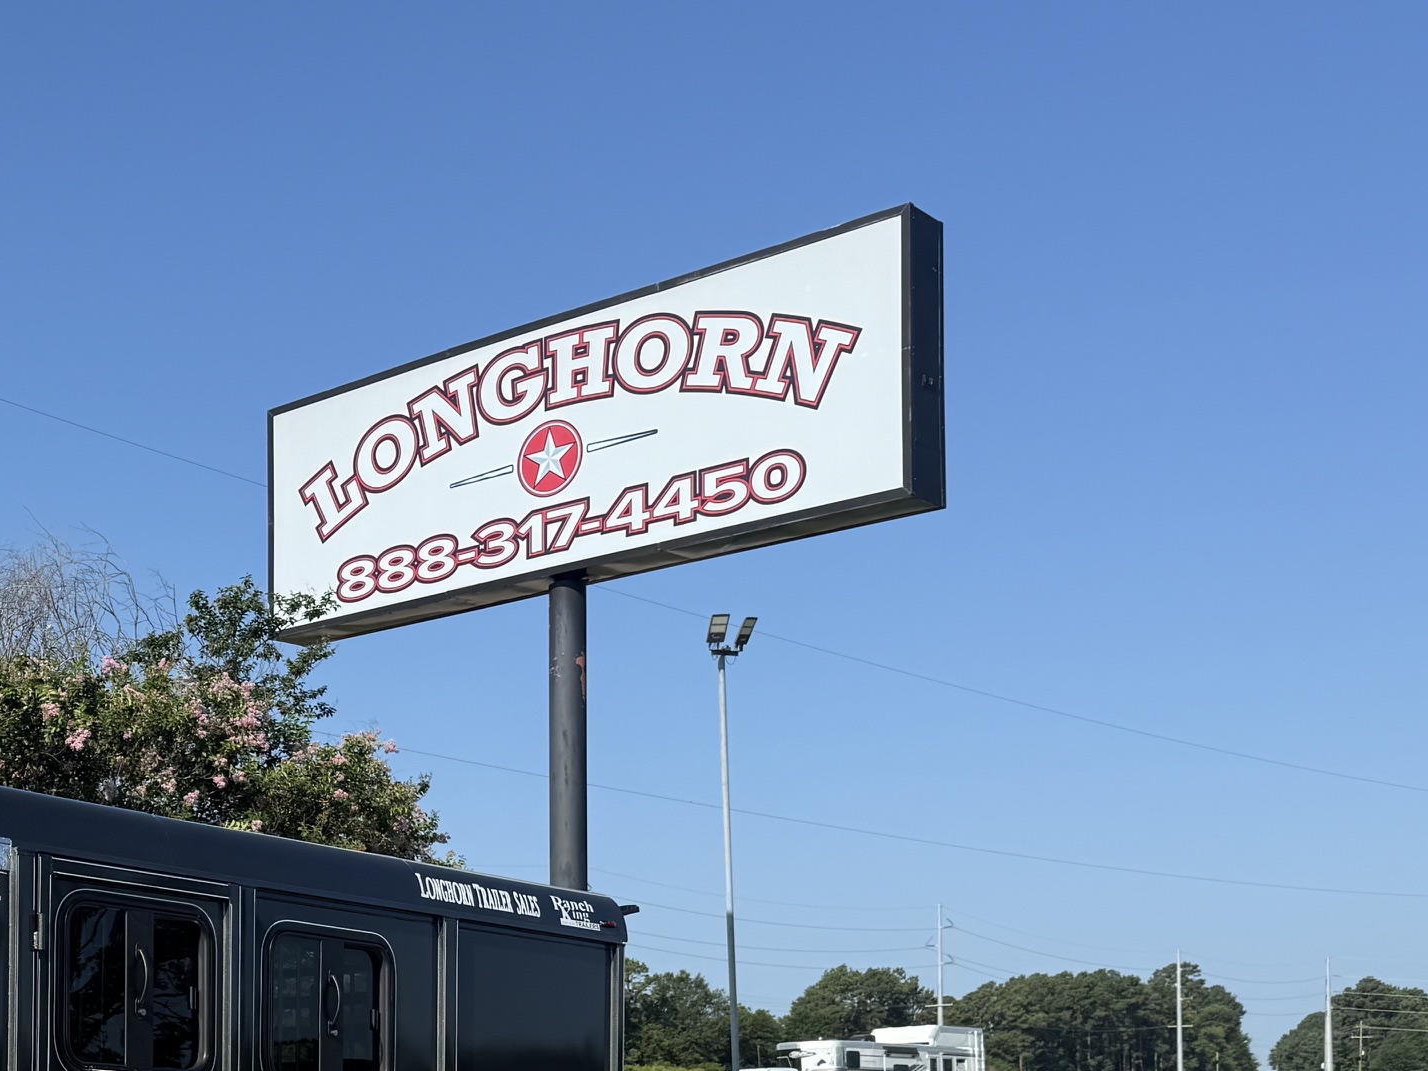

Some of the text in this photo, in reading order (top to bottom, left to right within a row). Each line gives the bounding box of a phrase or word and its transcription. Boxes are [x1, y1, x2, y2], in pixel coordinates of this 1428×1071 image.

[300, 310, 862, 543] LONGHORN
[336, 448, 807, 603] 888-317-4450
[414, 872, 541, 918] LONGHORN TRAILER SALES
[549, 895, 594, 914] Ranch
[561, 907, 590, 923] King
